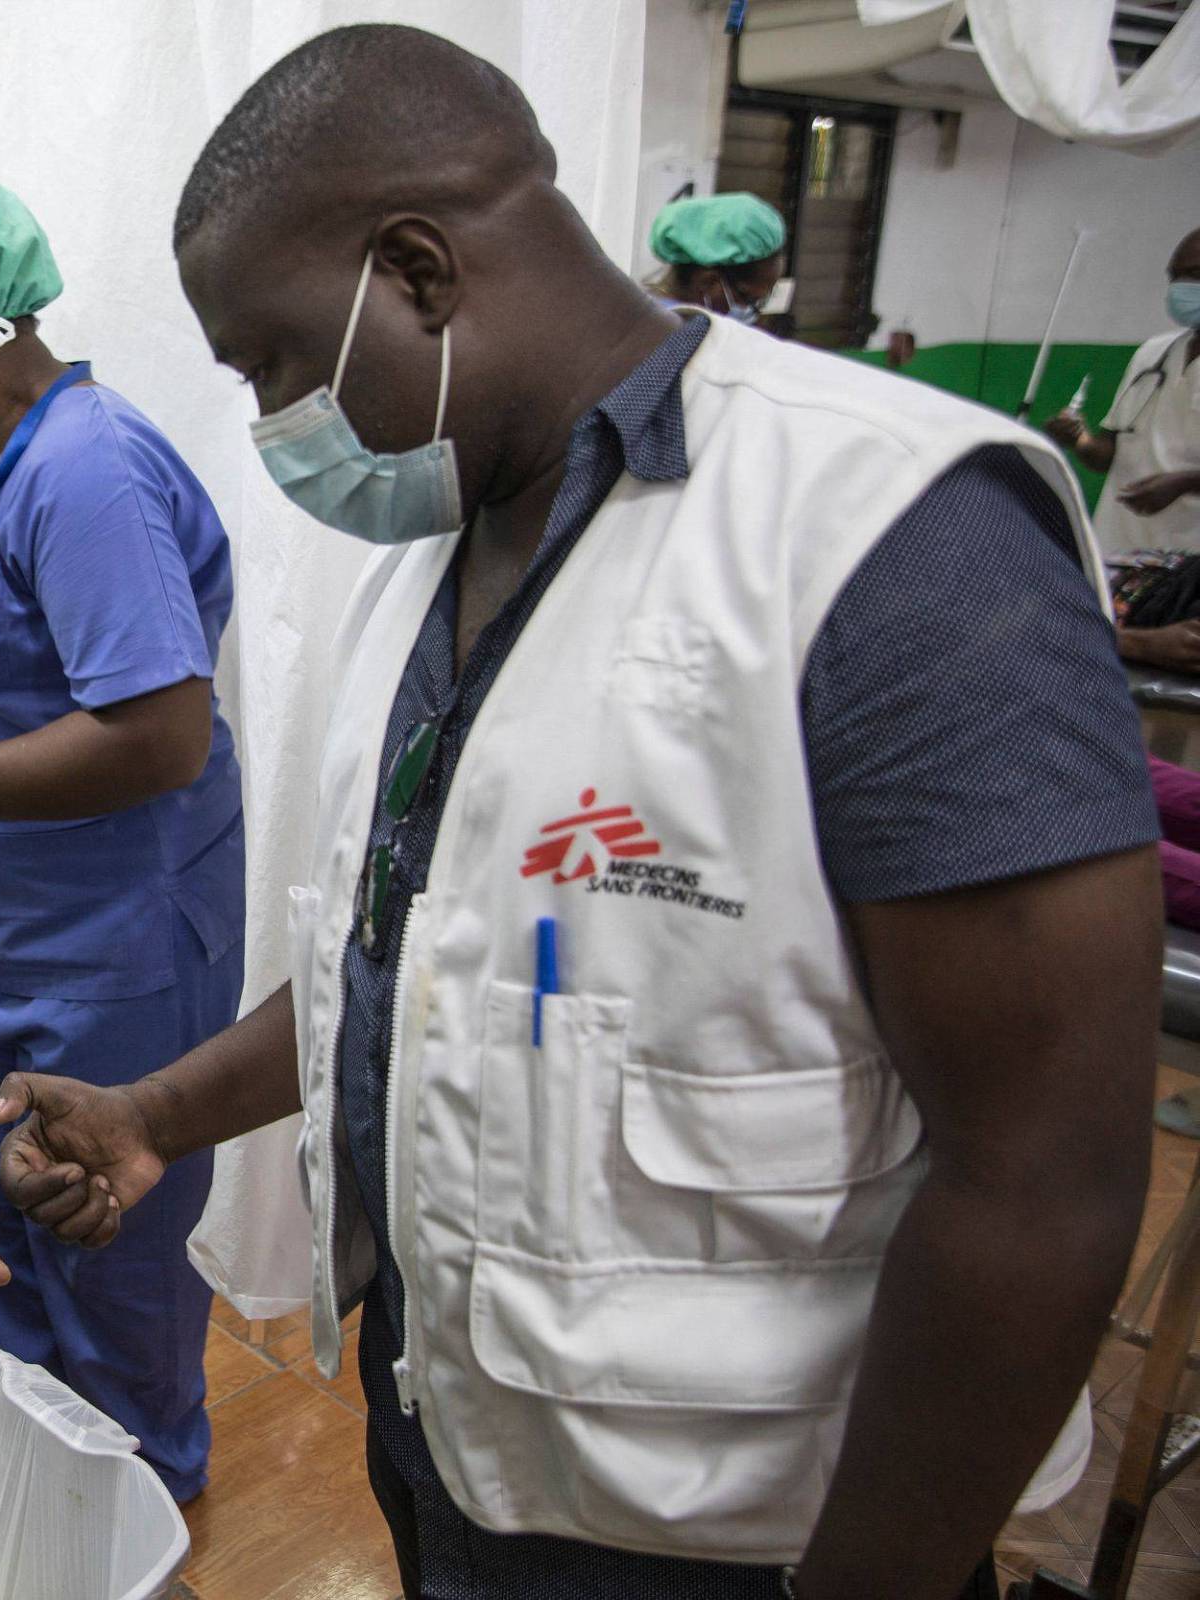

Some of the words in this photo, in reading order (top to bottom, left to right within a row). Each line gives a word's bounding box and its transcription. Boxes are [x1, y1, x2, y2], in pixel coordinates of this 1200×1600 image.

[606, 860, 700, 888] MEDECINS
[586, 876, 634, 895] SANS
[638, 881, 745, 919] FRONTIERES
